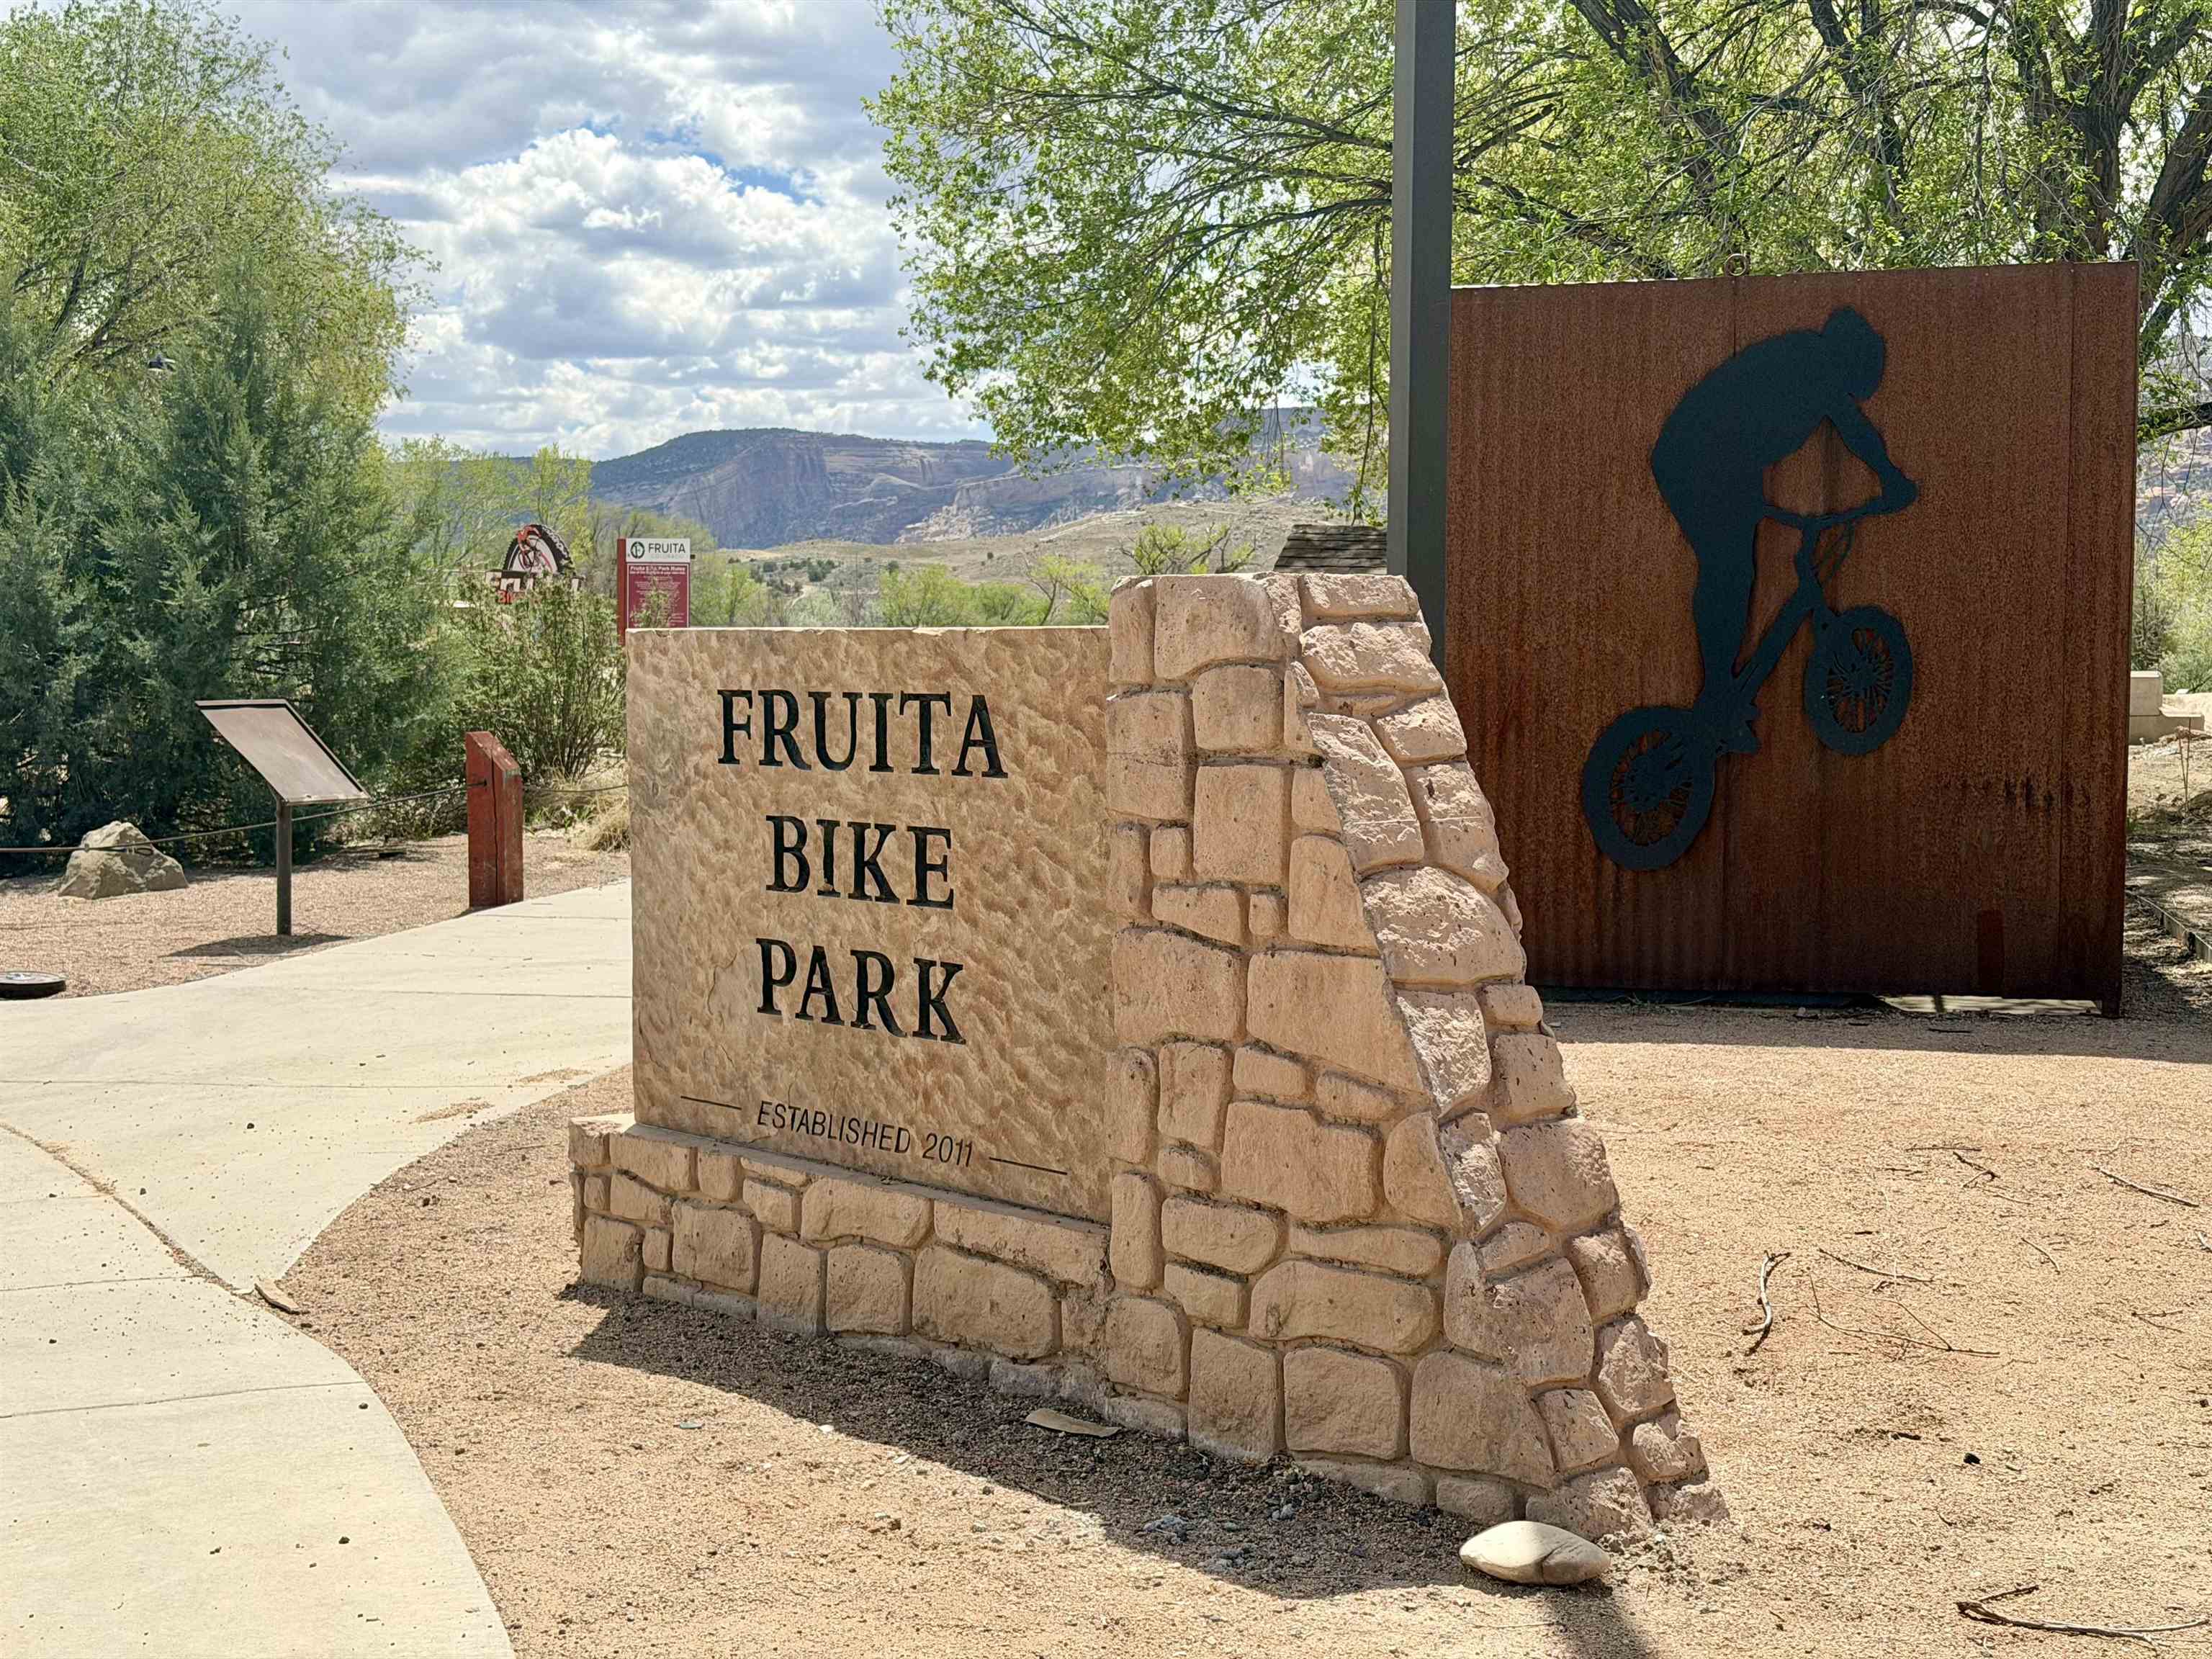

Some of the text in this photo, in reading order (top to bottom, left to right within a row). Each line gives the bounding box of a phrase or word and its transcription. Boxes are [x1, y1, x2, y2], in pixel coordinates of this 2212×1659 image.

[648, 543, 686, 554] FRUITA
[717, 688, 1009, 778] FRUITA
[765, 814, 955, 910] BIKE
[755, 937, 967, 1046] PARK
[757, 1100, 973, 1168] ESTABLISHED 2011
